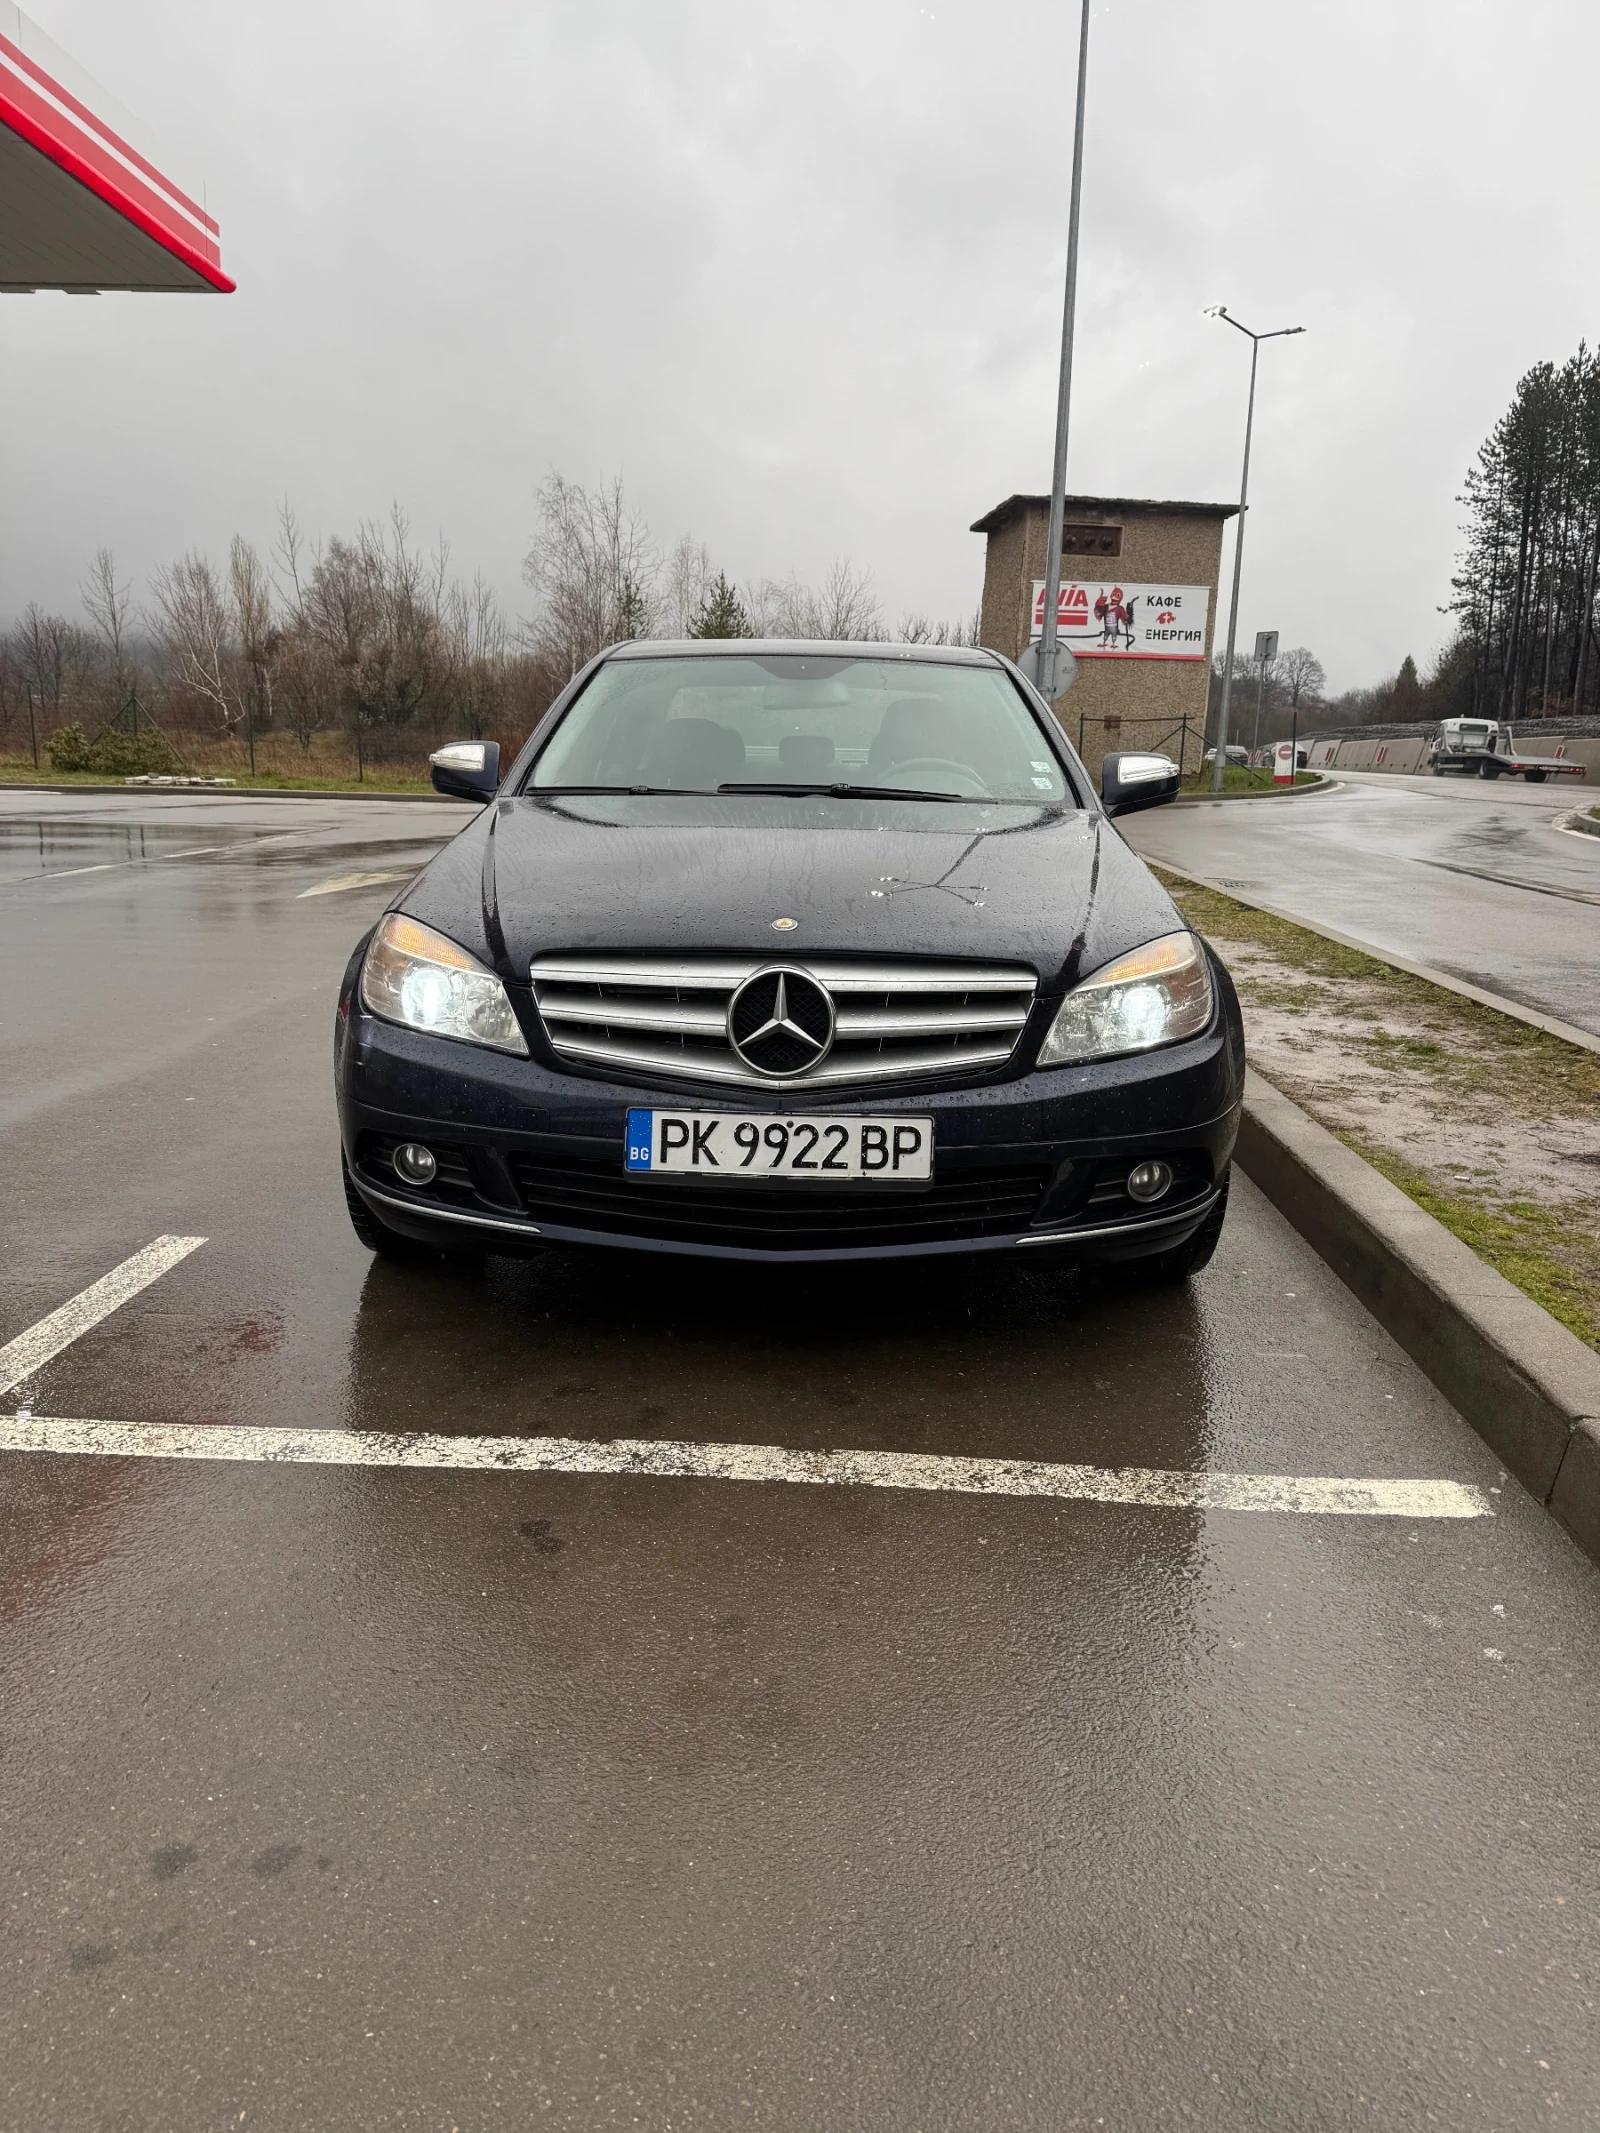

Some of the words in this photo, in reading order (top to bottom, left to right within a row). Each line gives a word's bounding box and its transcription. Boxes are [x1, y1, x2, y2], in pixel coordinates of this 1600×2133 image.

[1146, 595, 1182, 608] КАФЕ
[1145, 628, 1202, 641] ЕНЕРГИЯ
[660, 1118, 720, 1166] PK
[733, 1121, 849, 1170] 9922
[859, 1124, 922, 1171] BP
[629, 1146, 650, 1161] BG
